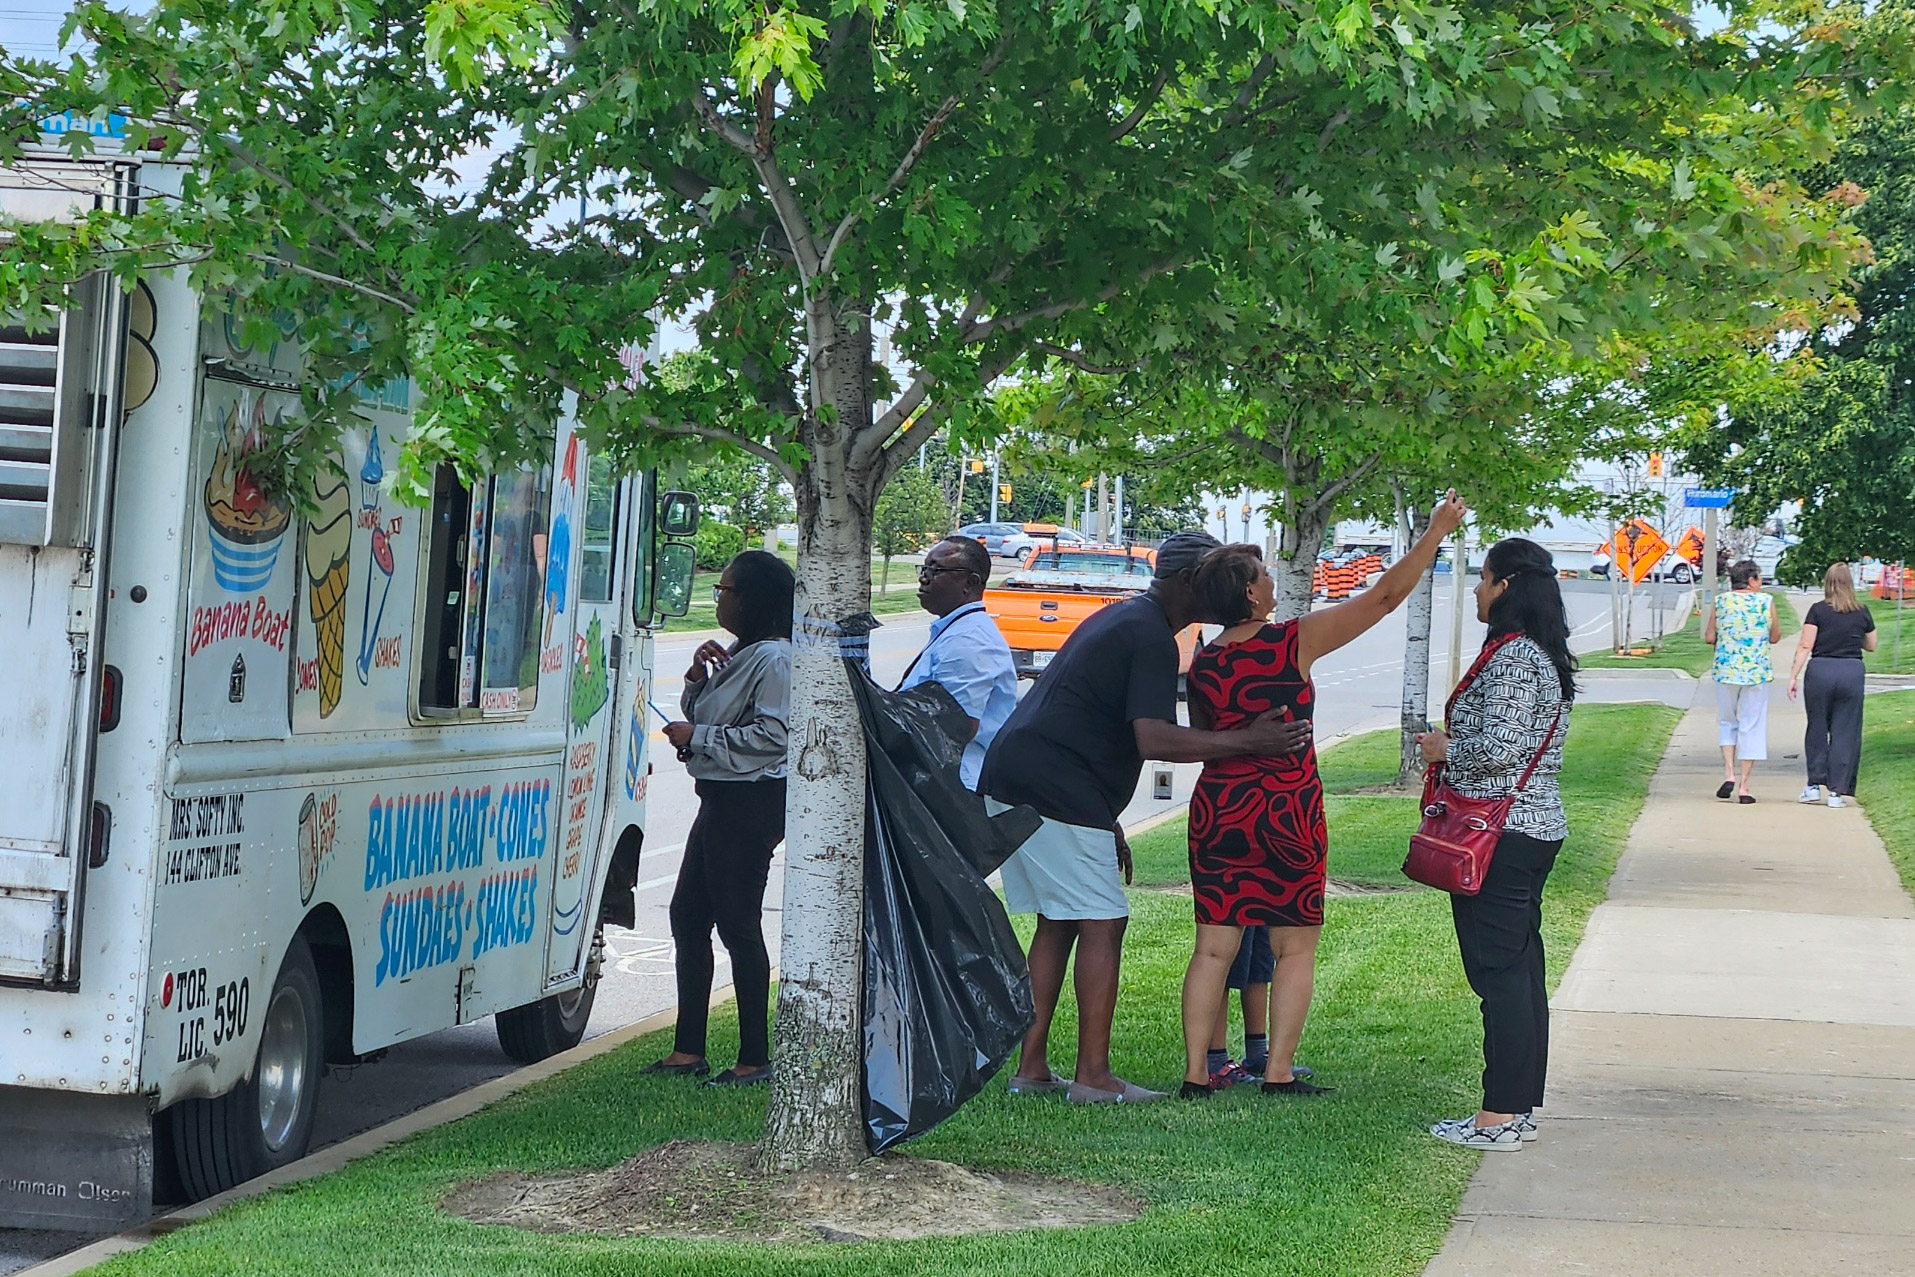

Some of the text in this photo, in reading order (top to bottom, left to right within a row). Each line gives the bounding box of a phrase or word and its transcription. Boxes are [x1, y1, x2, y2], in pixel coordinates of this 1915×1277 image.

[190, 595, 290, 657] Banana Boat
[374, 633, 402, 670] SHAKES
[482, 691, 497, 709] CASH
[168, 793, 245, 841] MRS. SOFTY INC.
[319, 792, 337, 829] COLD
[319, 818, 336, 860] POP
[364, 794, 444, 892] BANANA
[446, 785, 491, 873] BOAT
[497, 777, 550, 862] CONES
[164, 842, 242, 886] 144 CLIFTON AVE.
[375, 863, 539, 988] SUNDAES SHAKES
[177, 967, 210, 1013] TOR.
[213, 976, 249, 1047] 590
[177, 1016, 208, 1064] LIC.
